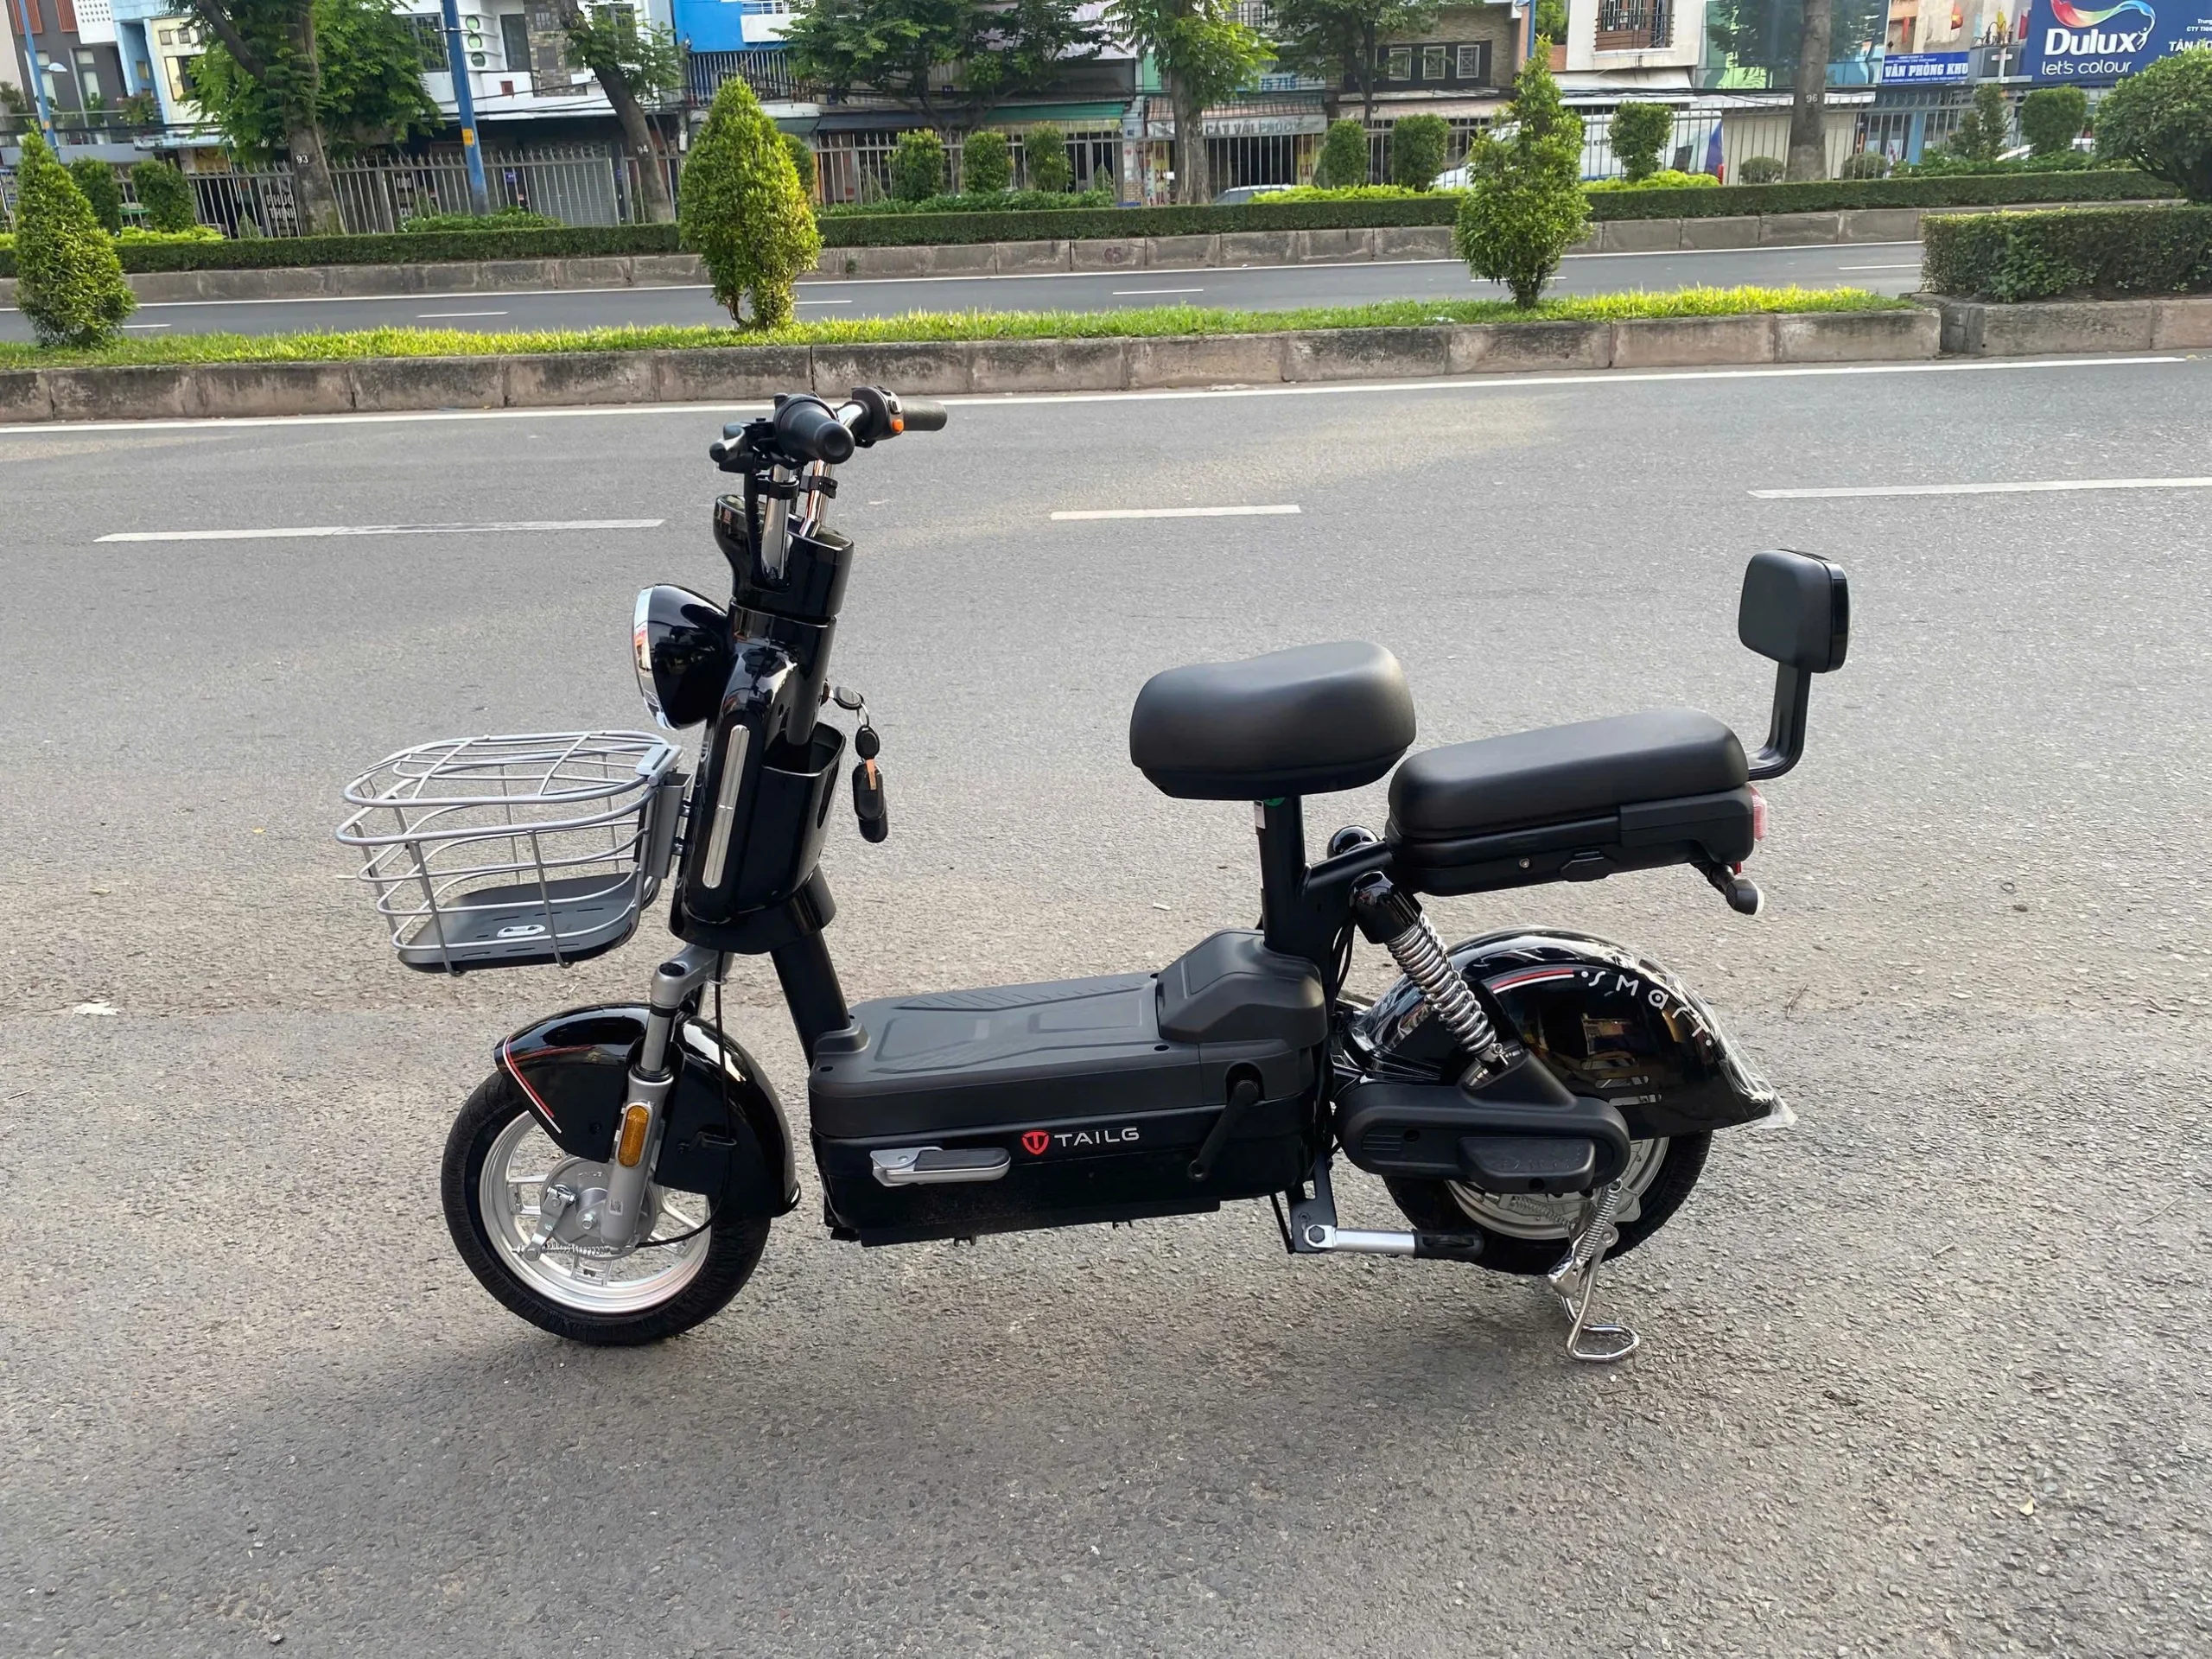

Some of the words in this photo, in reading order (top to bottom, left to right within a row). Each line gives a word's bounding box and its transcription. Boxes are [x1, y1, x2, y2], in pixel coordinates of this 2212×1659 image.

[2044, 29, 2138, 55] Dulux
[1947, 62, 1969, 75] KHU
[2042, 59, 2074, 75] let's
[2078, 59, 2132, 74] colour
[1806, 93, 1819, 103] 96
[637, 144, 649, 155] 94
[296, 155, 309, 164] 93
[1053, 1127, 1140, 1147] TAILG
